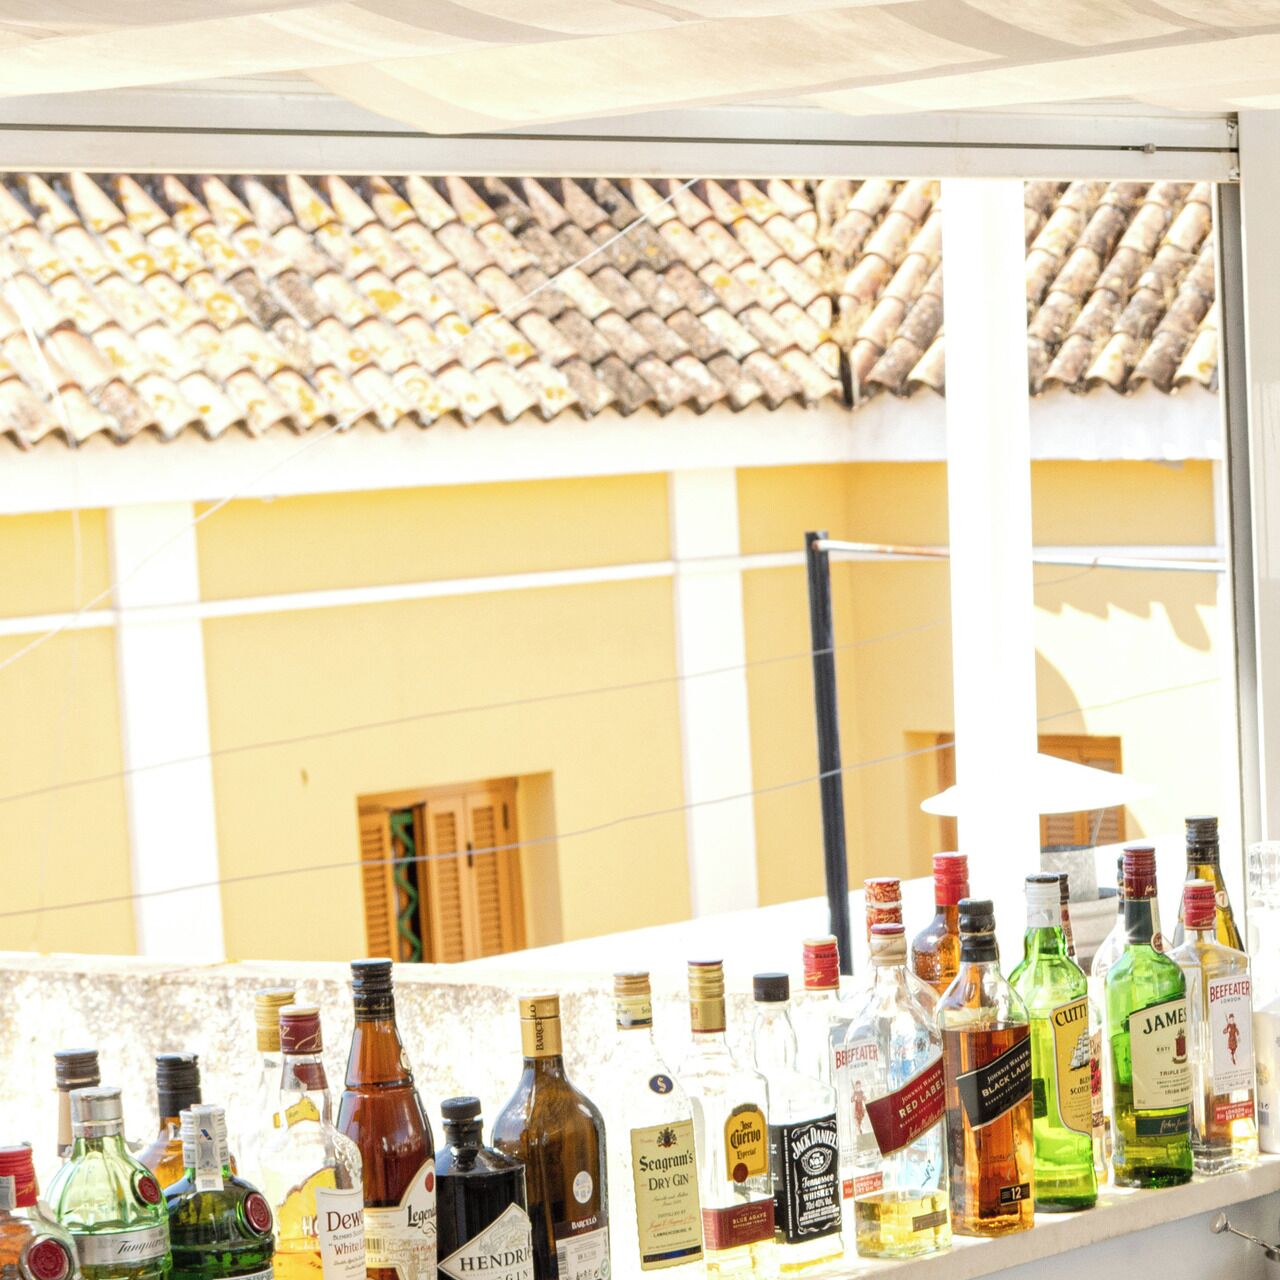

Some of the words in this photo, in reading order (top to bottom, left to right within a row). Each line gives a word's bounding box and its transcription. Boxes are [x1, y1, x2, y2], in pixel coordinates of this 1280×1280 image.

[1209, 980, 1250, 1002] BEEFEATER
[836, 1043, 878, 1069] BEEFEATER
[982, 1075, 1010, 1097] BLACK
[898, 1101, 918, 1119] RED
[919, 1079, 945, 1104] LABEL
[730, 1128, 761, 1149] Cuervo
[791, 1138, 812, 1160] JACK
[639, 1149, 693, 1172] Seagram's
[648, 1175, 671, 1191] DRY
[672, 1173, 689, 1187] GIN
[803, 1187, 834, 1201] WHISKEY
[1011, 1187, 1021, 1200] 12
[733, 1216, 748, 1225] BLUE
